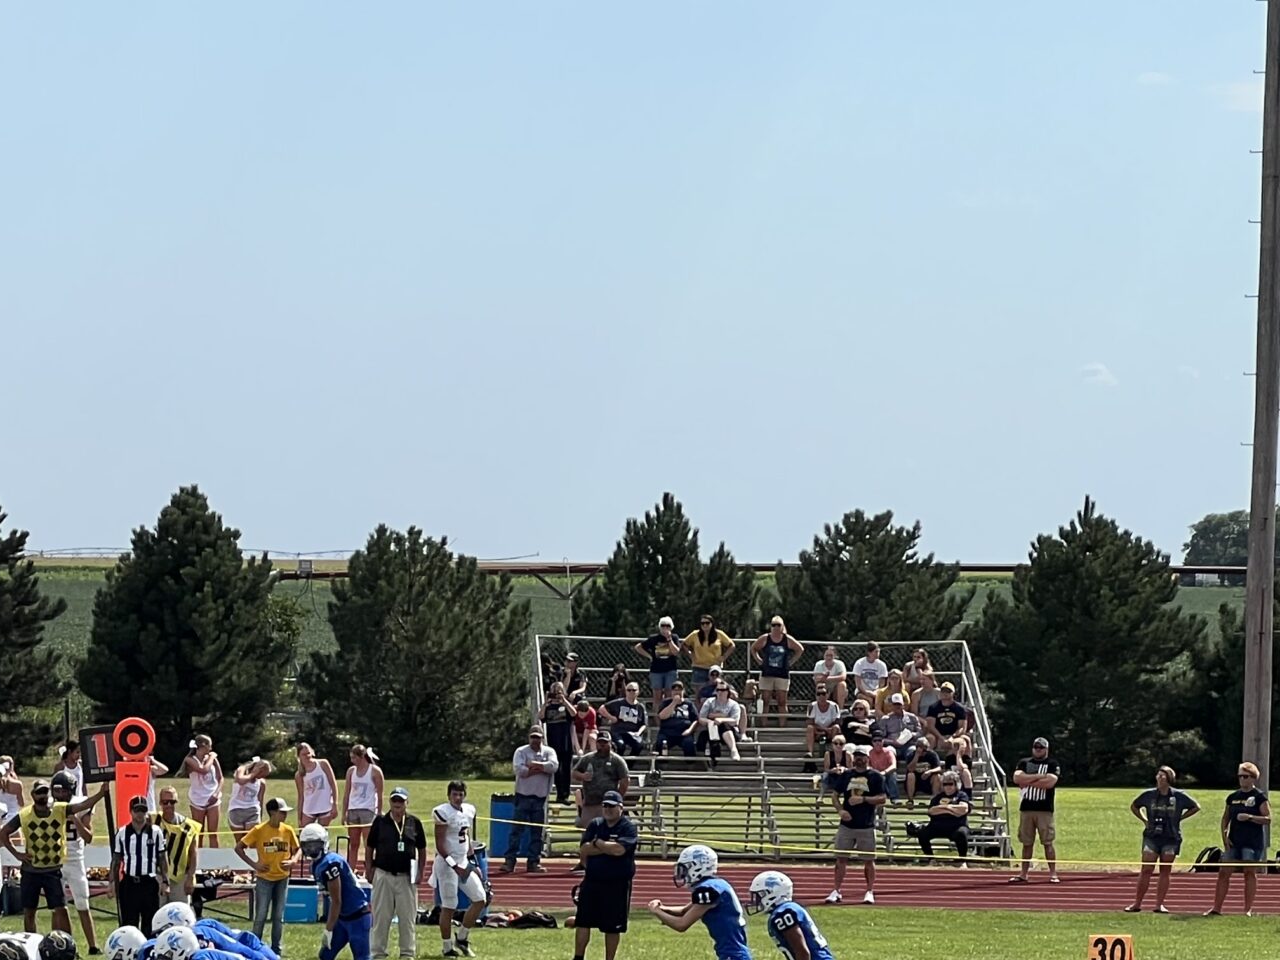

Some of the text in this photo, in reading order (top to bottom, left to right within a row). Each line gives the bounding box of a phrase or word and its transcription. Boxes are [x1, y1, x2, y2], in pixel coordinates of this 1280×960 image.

[91, 734, 109, 768] 1
[325, 866, 340, 880] 12
[698, 892, 711, 904] 11
[774, 913, 795, 931] 20
